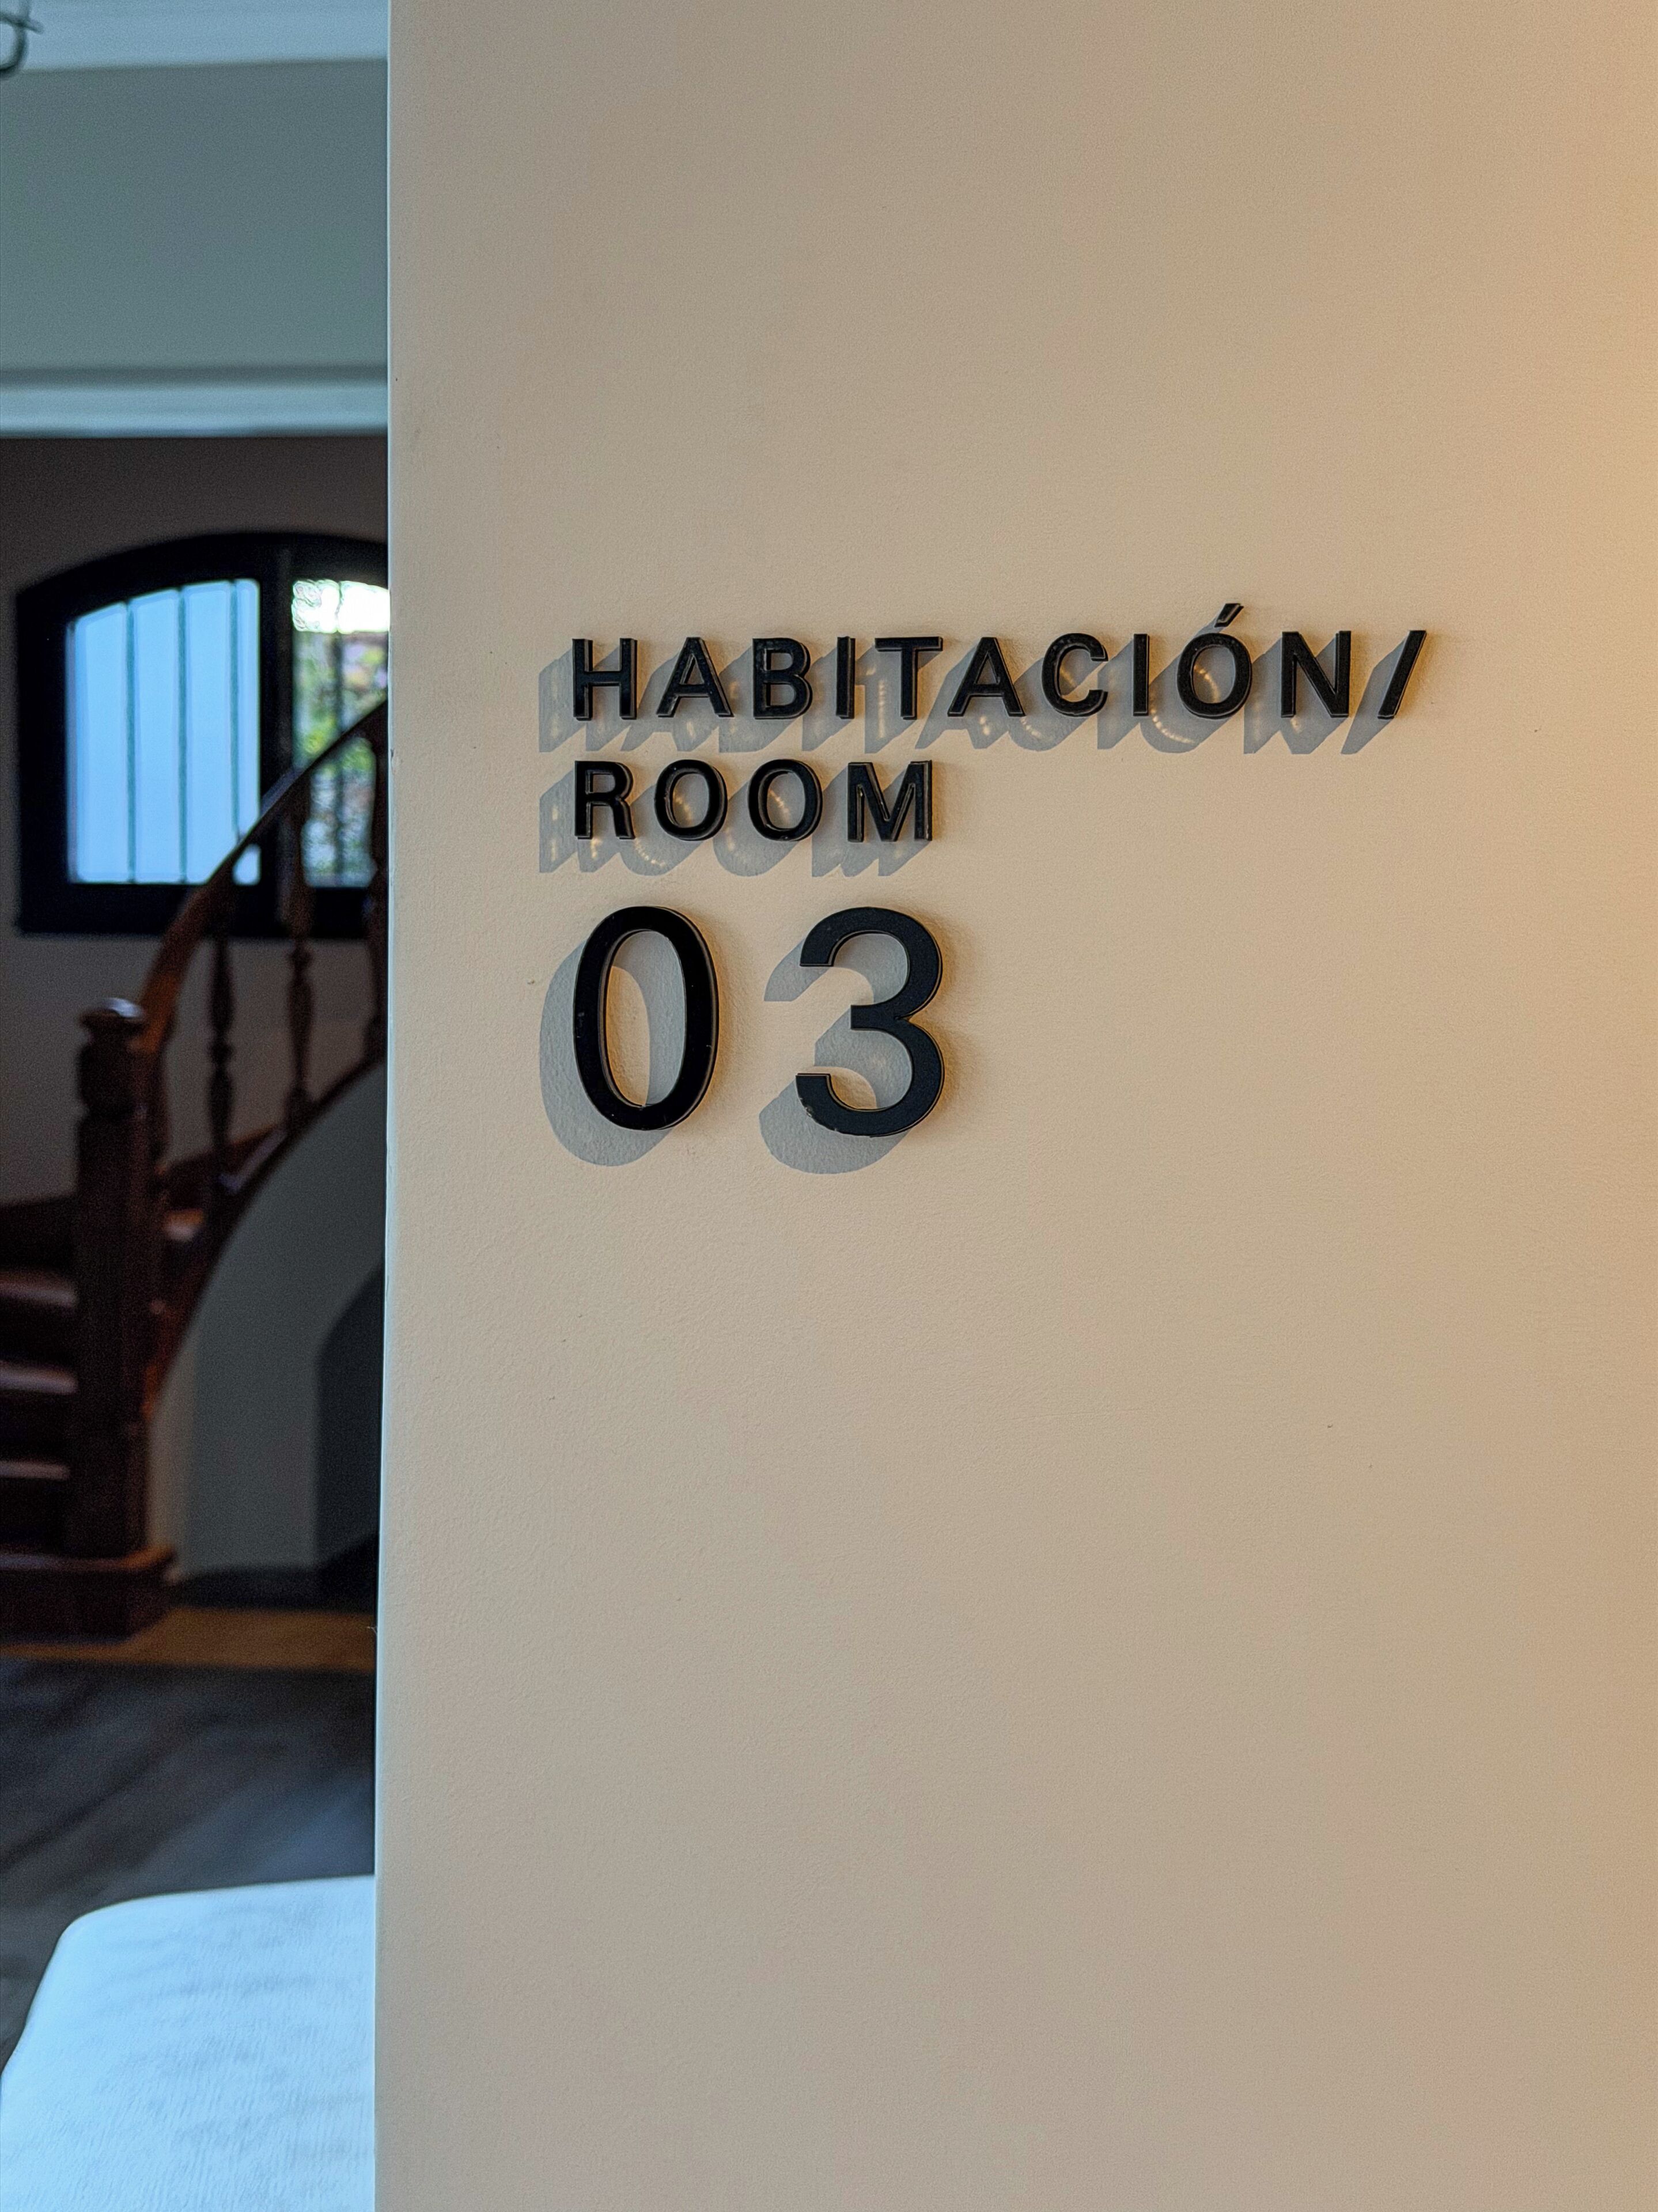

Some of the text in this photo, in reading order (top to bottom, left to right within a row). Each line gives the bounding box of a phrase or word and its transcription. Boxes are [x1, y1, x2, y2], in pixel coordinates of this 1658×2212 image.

[572, 603, 1427, 721] HABITACIÓN/
[574, 759, 933, 843] ROOM
[573, 906, 945, 1138] 03
